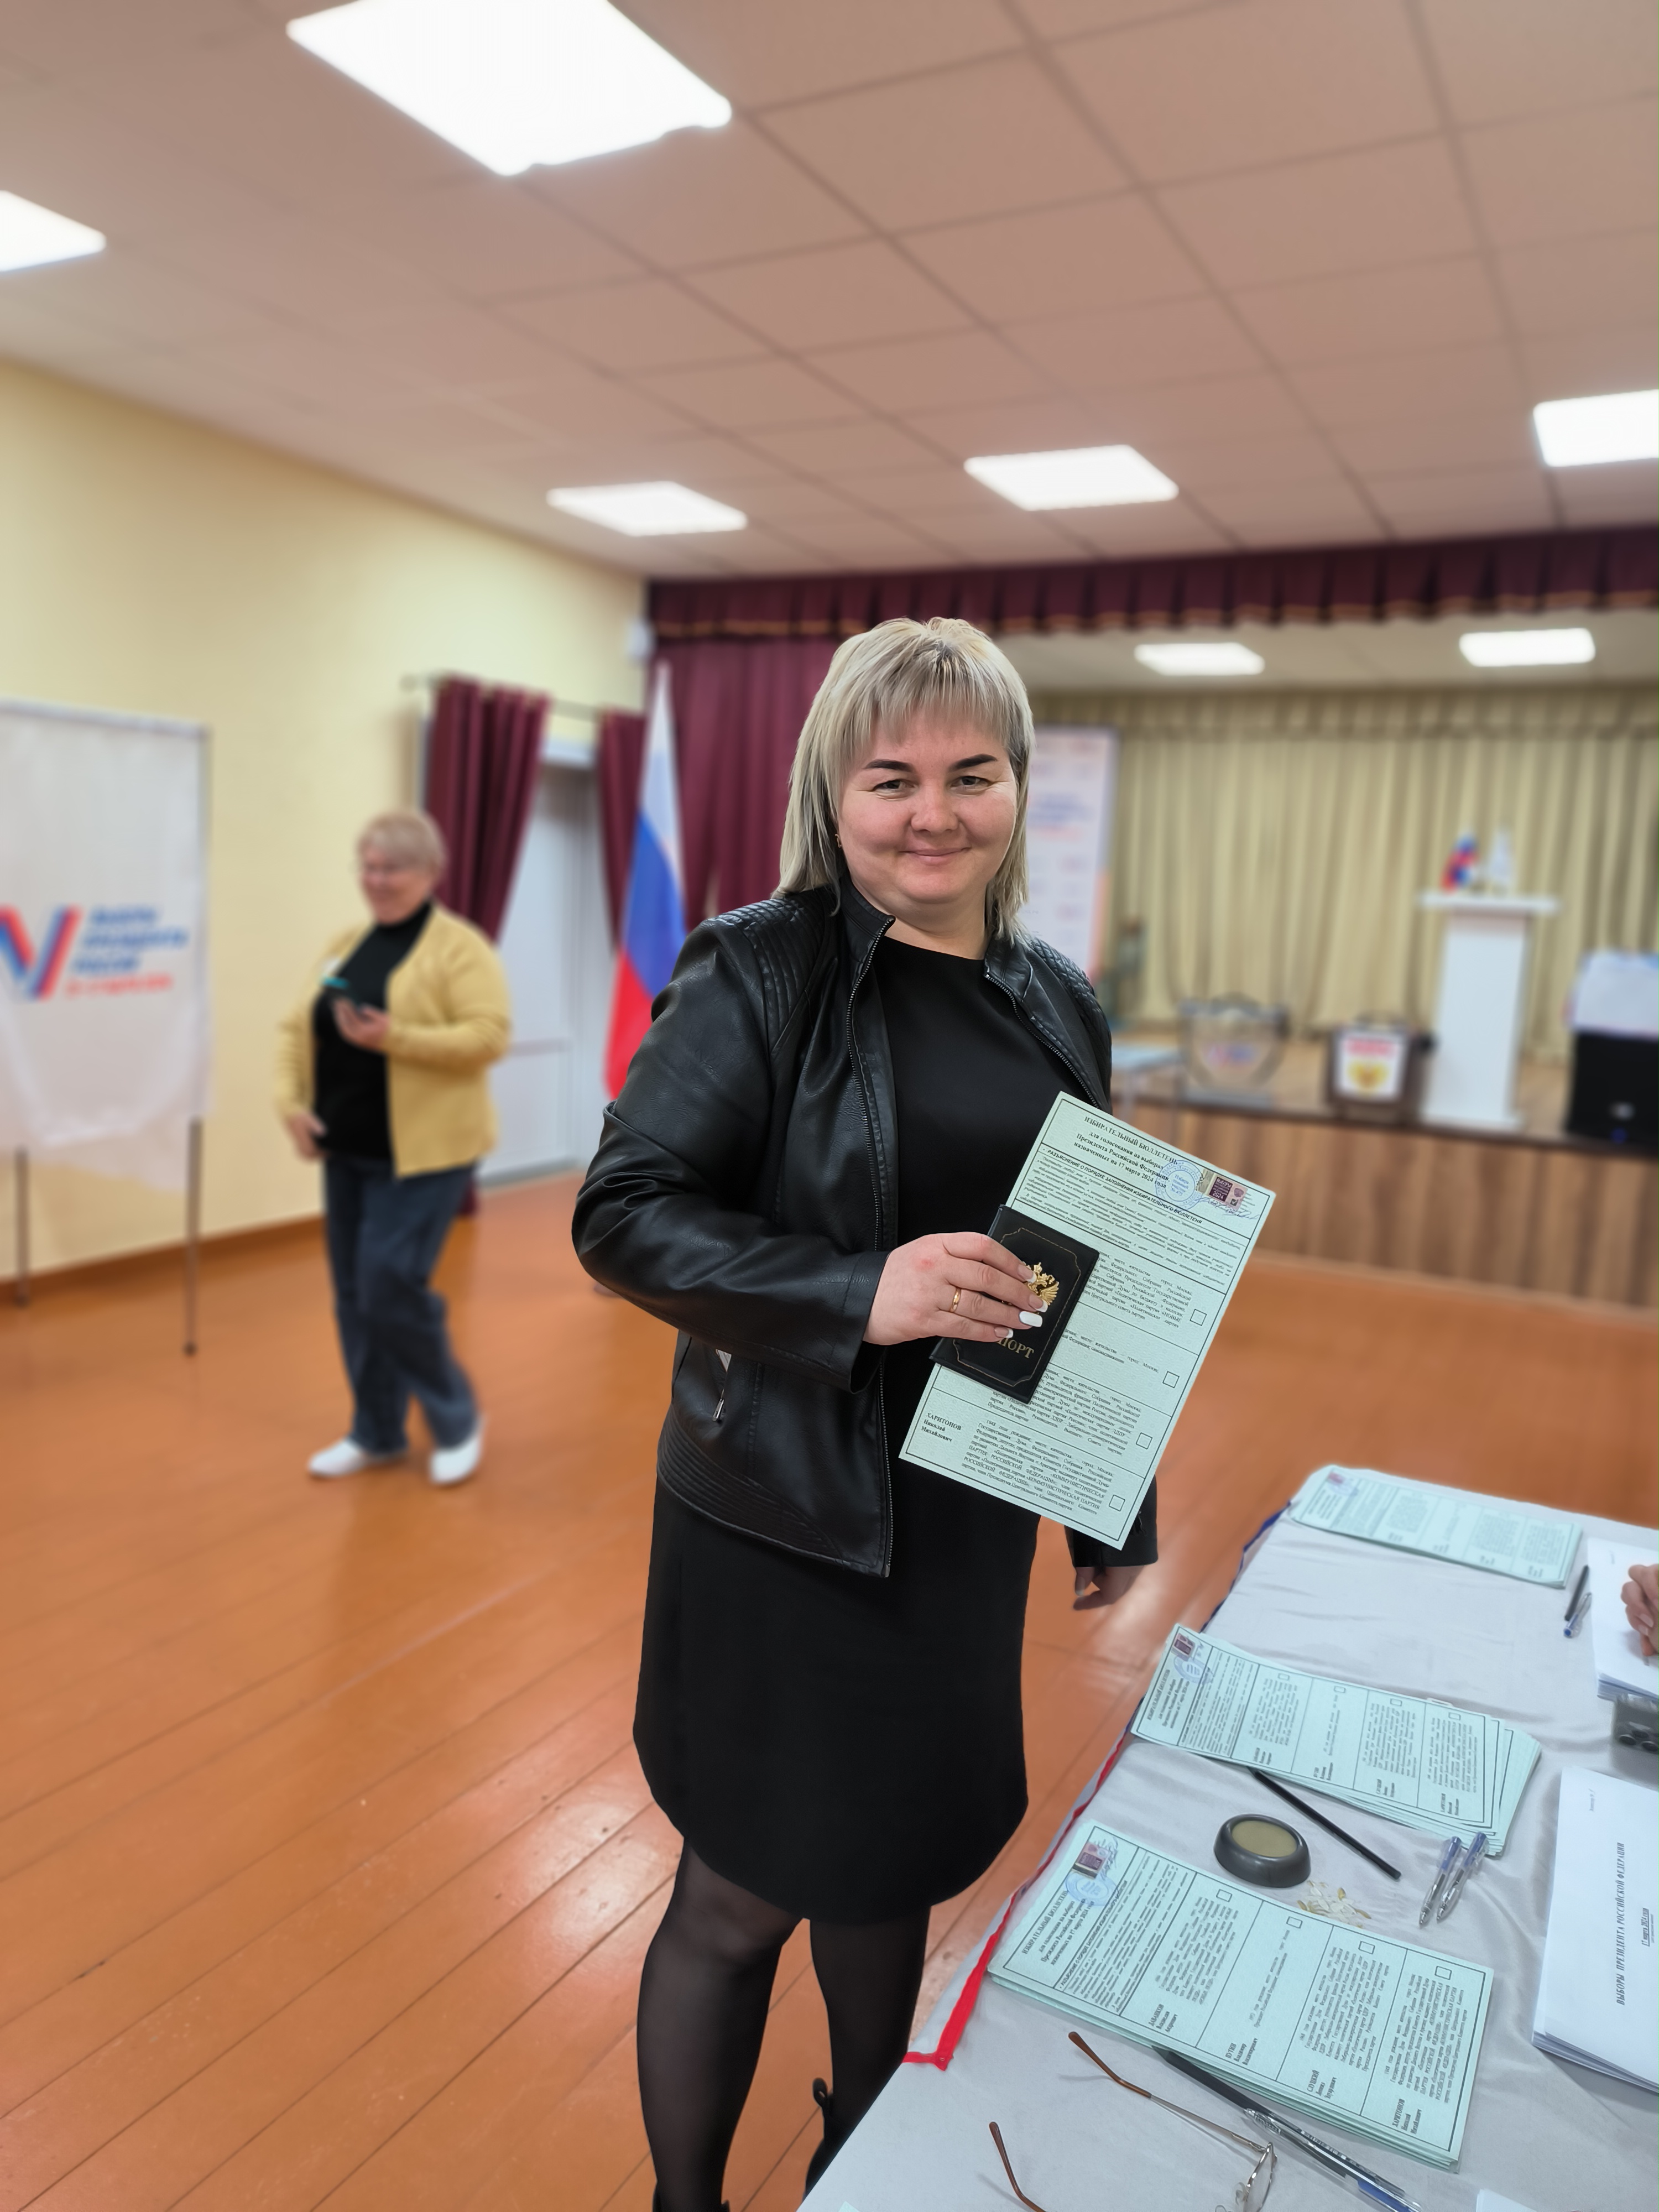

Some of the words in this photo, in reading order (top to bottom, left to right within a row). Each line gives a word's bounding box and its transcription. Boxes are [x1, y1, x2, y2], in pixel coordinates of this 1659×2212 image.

[1084, 1116, 1139, 1146] ИЗБИРАТЕЛЬНЫЙ
[1076, 1133, 1108, 1152] Президента
[1109, 1149, 1139, 1166] Российской
[1100, 1137, 1133, 1155] голосования
[1141, 1156, 1165, 1170] выборах
[1074, 1142, 1109, 1161] назначенных
[1125, 1166, 1140, 1176] марта
[1141, 1173, 1154, 1182] 2024
[1154, 1178, 1166, 1189] года
[1047, 1150, 1080, 1167] РАЗЪЯСНЕНИЕ
[1084, 1167, 1105, 1180] ПОРЯДКЕ
[1105, 1177, 1134, 1192] ЗАПОЛНЕНИЯ
[1133, 1191, 1173, 1211] ИЗБИРАТЕЛЬНОГО
[1173, 1209, 1202, 1224] БЮЛЛЕТЕНЯ
[1212, 1190, 1224, 1199] 2024
[998, 1338, 1034, 1359] ПОРТ
[921, 1426, 952, 1442] Михайлович
[924, 1419, 945, 1432] Николай
[927, 1412, 962, 1430] ХАРИТОНОВ
[1616, 1842, 1625, 1879] ФЕДЕРАЦИИ
[1615, 1880, 1625, 1926] РОССИЙСКОЙ
[1616, 1926, 1625, 1971] ПРЕЗИДЕНТА
[1616, 1974, 1625, 2006] ВЫБОРЫ
[1225, 2042, 1237, 2059] ПУТИН
[1306, 2069, 1319, 2092] СЛУЦКИЙ
[1391, 2098, 1405, 2127] ХАРИТОНОВ
